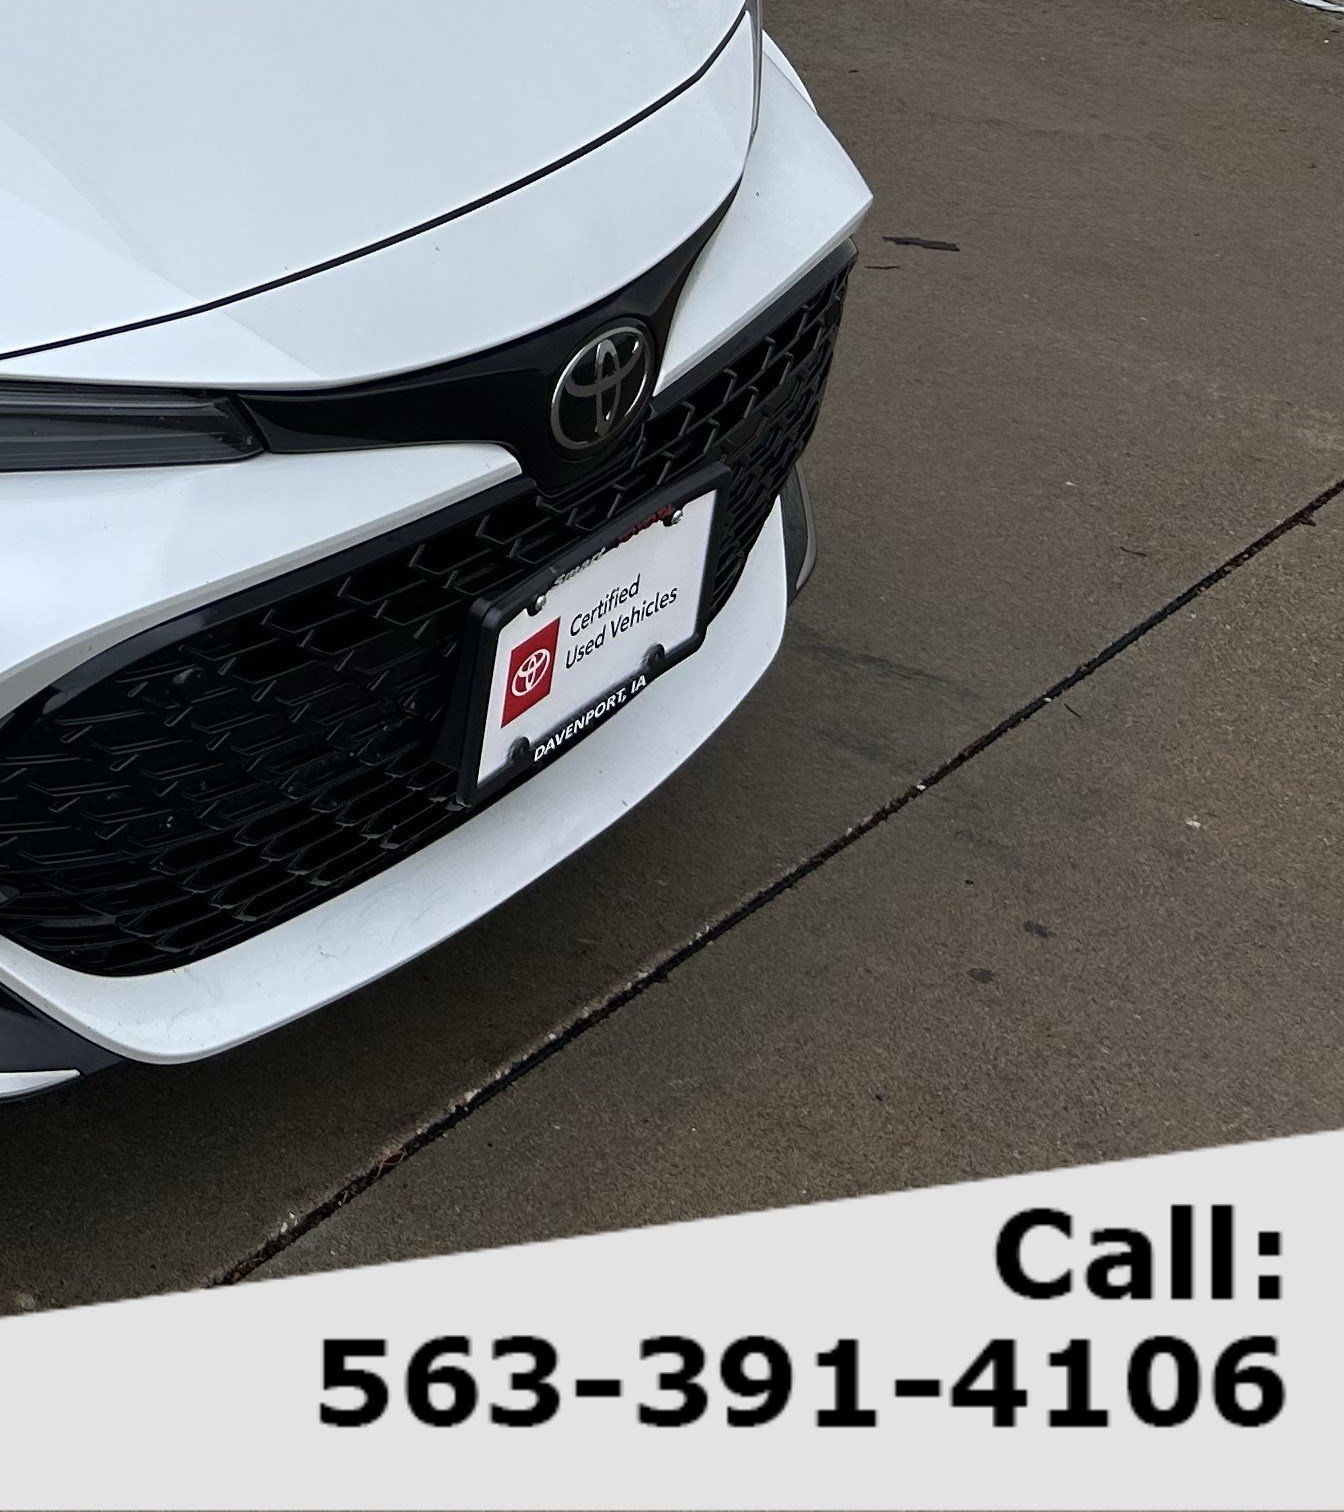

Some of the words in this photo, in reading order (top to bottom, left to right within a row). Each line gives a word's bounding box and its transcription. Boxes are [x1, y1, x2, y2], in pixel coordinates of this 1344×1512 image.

[565, 628, 605, 670] Used
[611, 586, 678, 638] Vehicles
[569, 572, 641, 637] Certified
[533, 687, 627, 762] DAVENPORT,
[631, 674, 647, 694] IA
